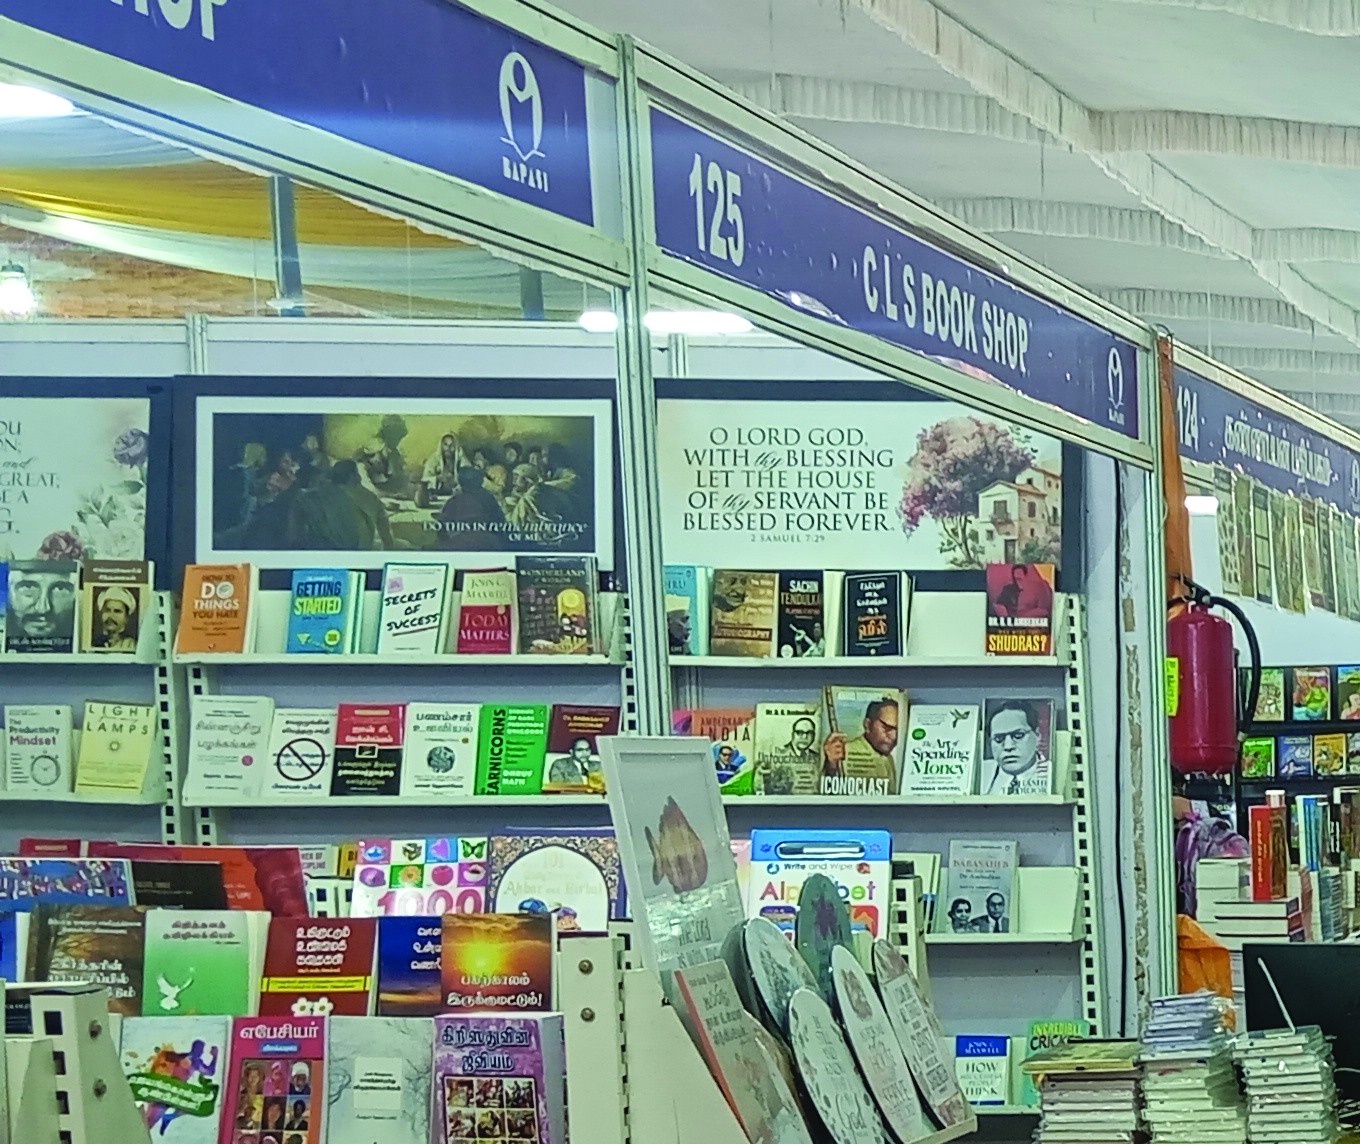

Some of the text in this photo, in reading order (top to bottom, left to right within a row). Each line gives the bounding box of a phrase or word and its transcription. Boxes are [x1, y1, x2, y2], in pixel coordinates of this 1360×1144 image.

[503, 156, 549, 193] BAPASI
[688, 152, 745, 268] 125
[863, 245, 1029, 374] C L S BOOK SHOP
[1176, 385, 1199, 453] 124
[709, 427, 728, 446] O
[737, 427, 800, 446] LORD
[684, 449, 893, 471] WITH thy BLESSING
[696, 470, 875, 488] LET THE HOUSE
[688, 491, 888, 514] OF thy SERVANT BE
[423, 521, 442, 532] DO
[445, 521, 470, 532] THIS
[473, 521, 487, 532] IN
[683, 512, 895, 531] BLESSED FOREVER.
[750, 534, 825, 543] 2 SAMUEL 7:29
[296, 580, 341, 596] GETTING
[790, 579, 819, 593] SACHIN
[193, 599, 240, 610] THINGS
[384, 587, 437, 606] SECRETS
[294, 598, 341, 615] STARTED
[404, 603, 421, 616] OF
[386, 613, 440, 632] SUCCESS
[463, 612, 509, 628] TODAY
[460, 629, 510, 641] MATTERS
[988, 635, 1047, 653] SHUDRAS?
[88, 704, 151, 717] LIGHT
[9, 726, 60, 735] Productivity
[86, 721, 149, 735] LAMPS
[10, 736, 56, 746] Mindset
[936, 738, 951, 748] Art
[911, 747, 971, 761] Spending
[910, 760, 967, 776] Money
[820, 775, 890, 796] ICONOCLAST
[784, 863, 806, 871] Write
[808, 862, 828, 870] and
[759, 881, 876, 904] Alpbet
[239, 1025, 320, 1043] எபேசியர்
[966, 1062, 999, 1073] HOW
[965, 1086, 998, 1096] THINK
